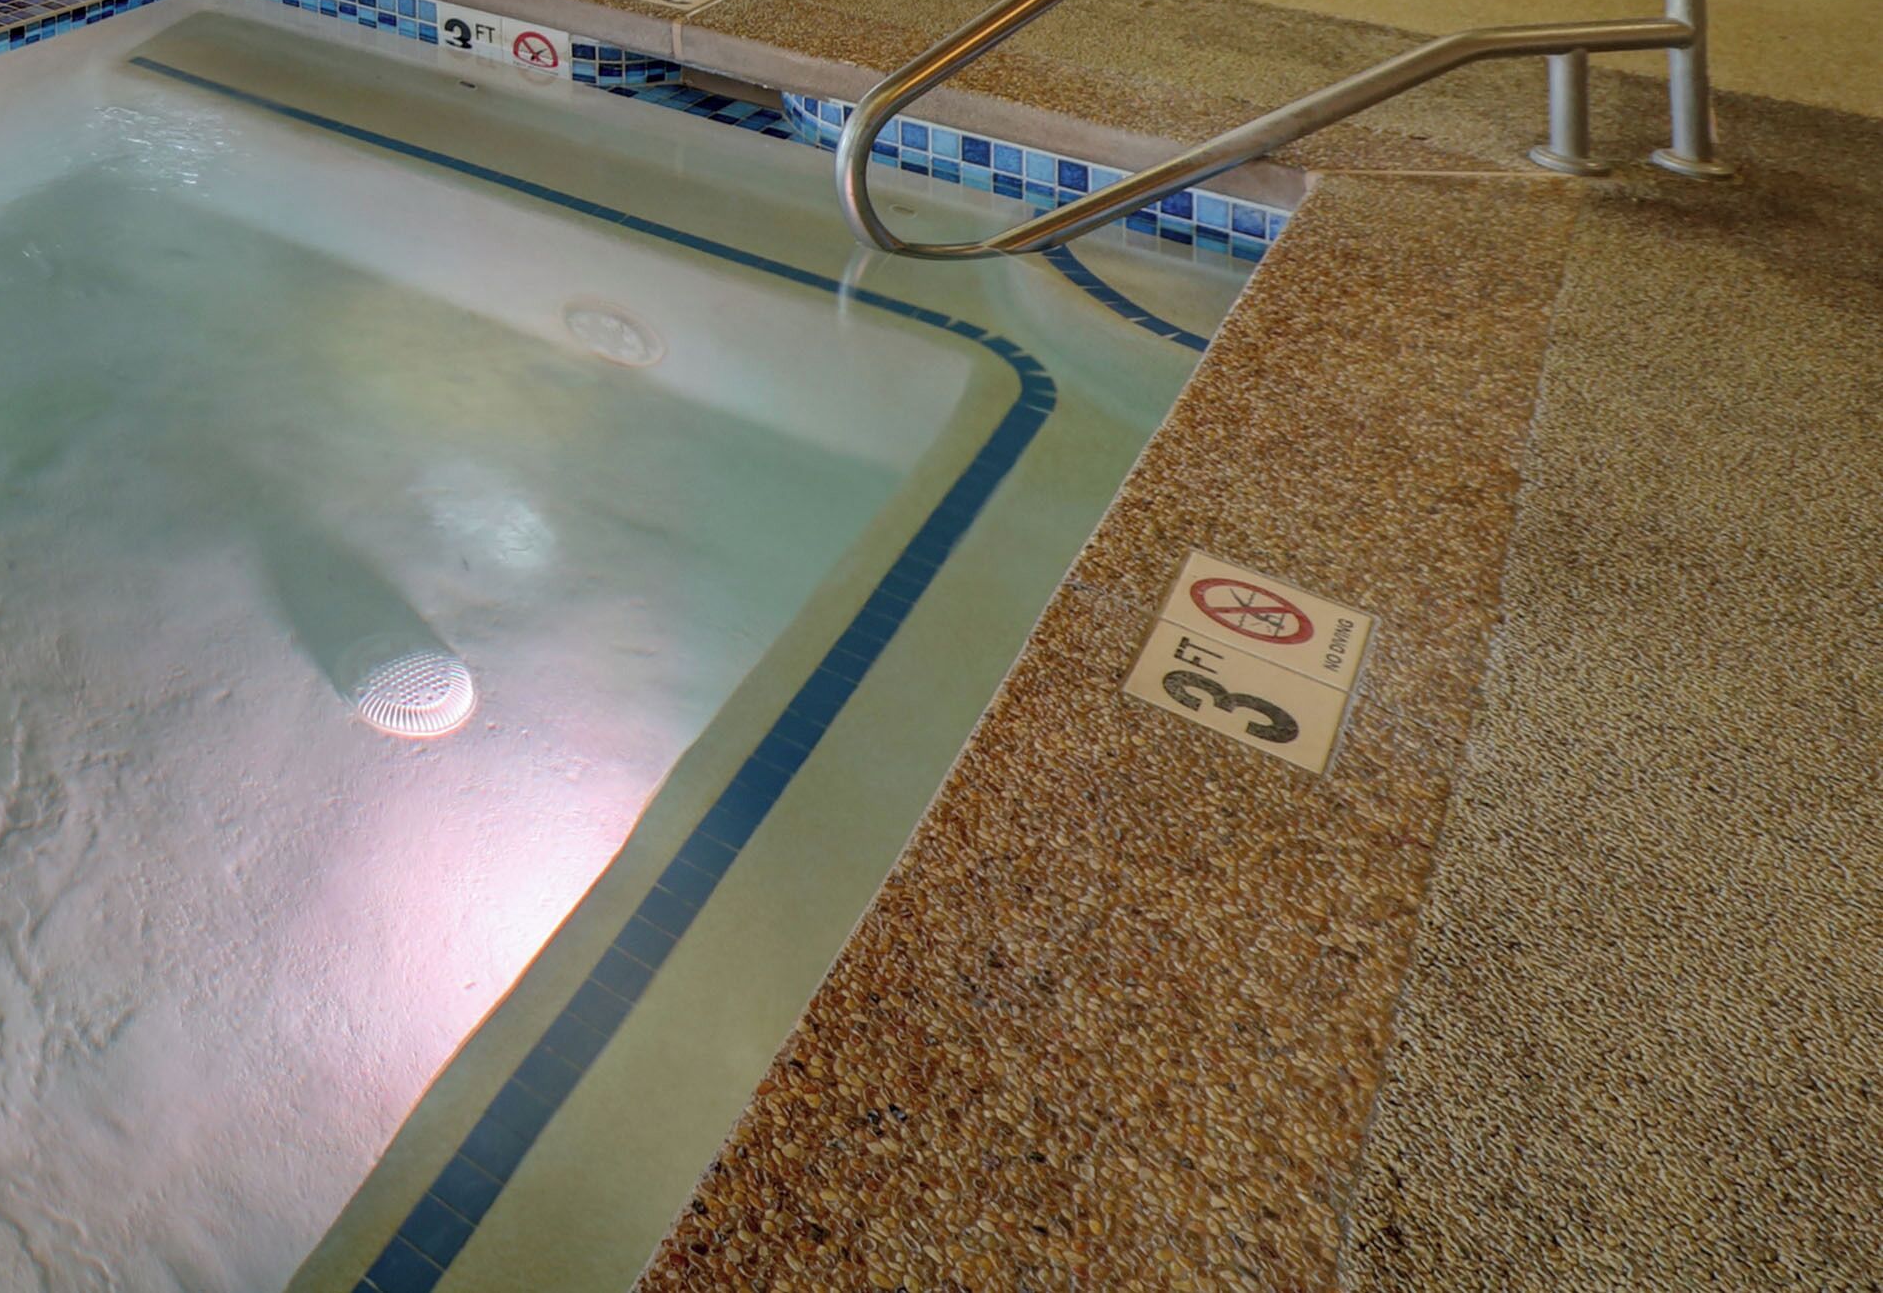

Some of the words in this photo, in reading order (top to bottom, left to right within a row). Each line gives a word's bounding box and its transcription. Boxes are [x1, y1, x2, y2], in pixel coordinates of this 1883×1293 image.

[444, 18, 472, 49] 3
[475, 23, 496, 44] FT
[1329, 618, 1354, 655] DIVING
[1174, 636, 1225, 675] FT
[1323, 653, 1342, 673] NO
[1162, 669, 1299, 744] 3
